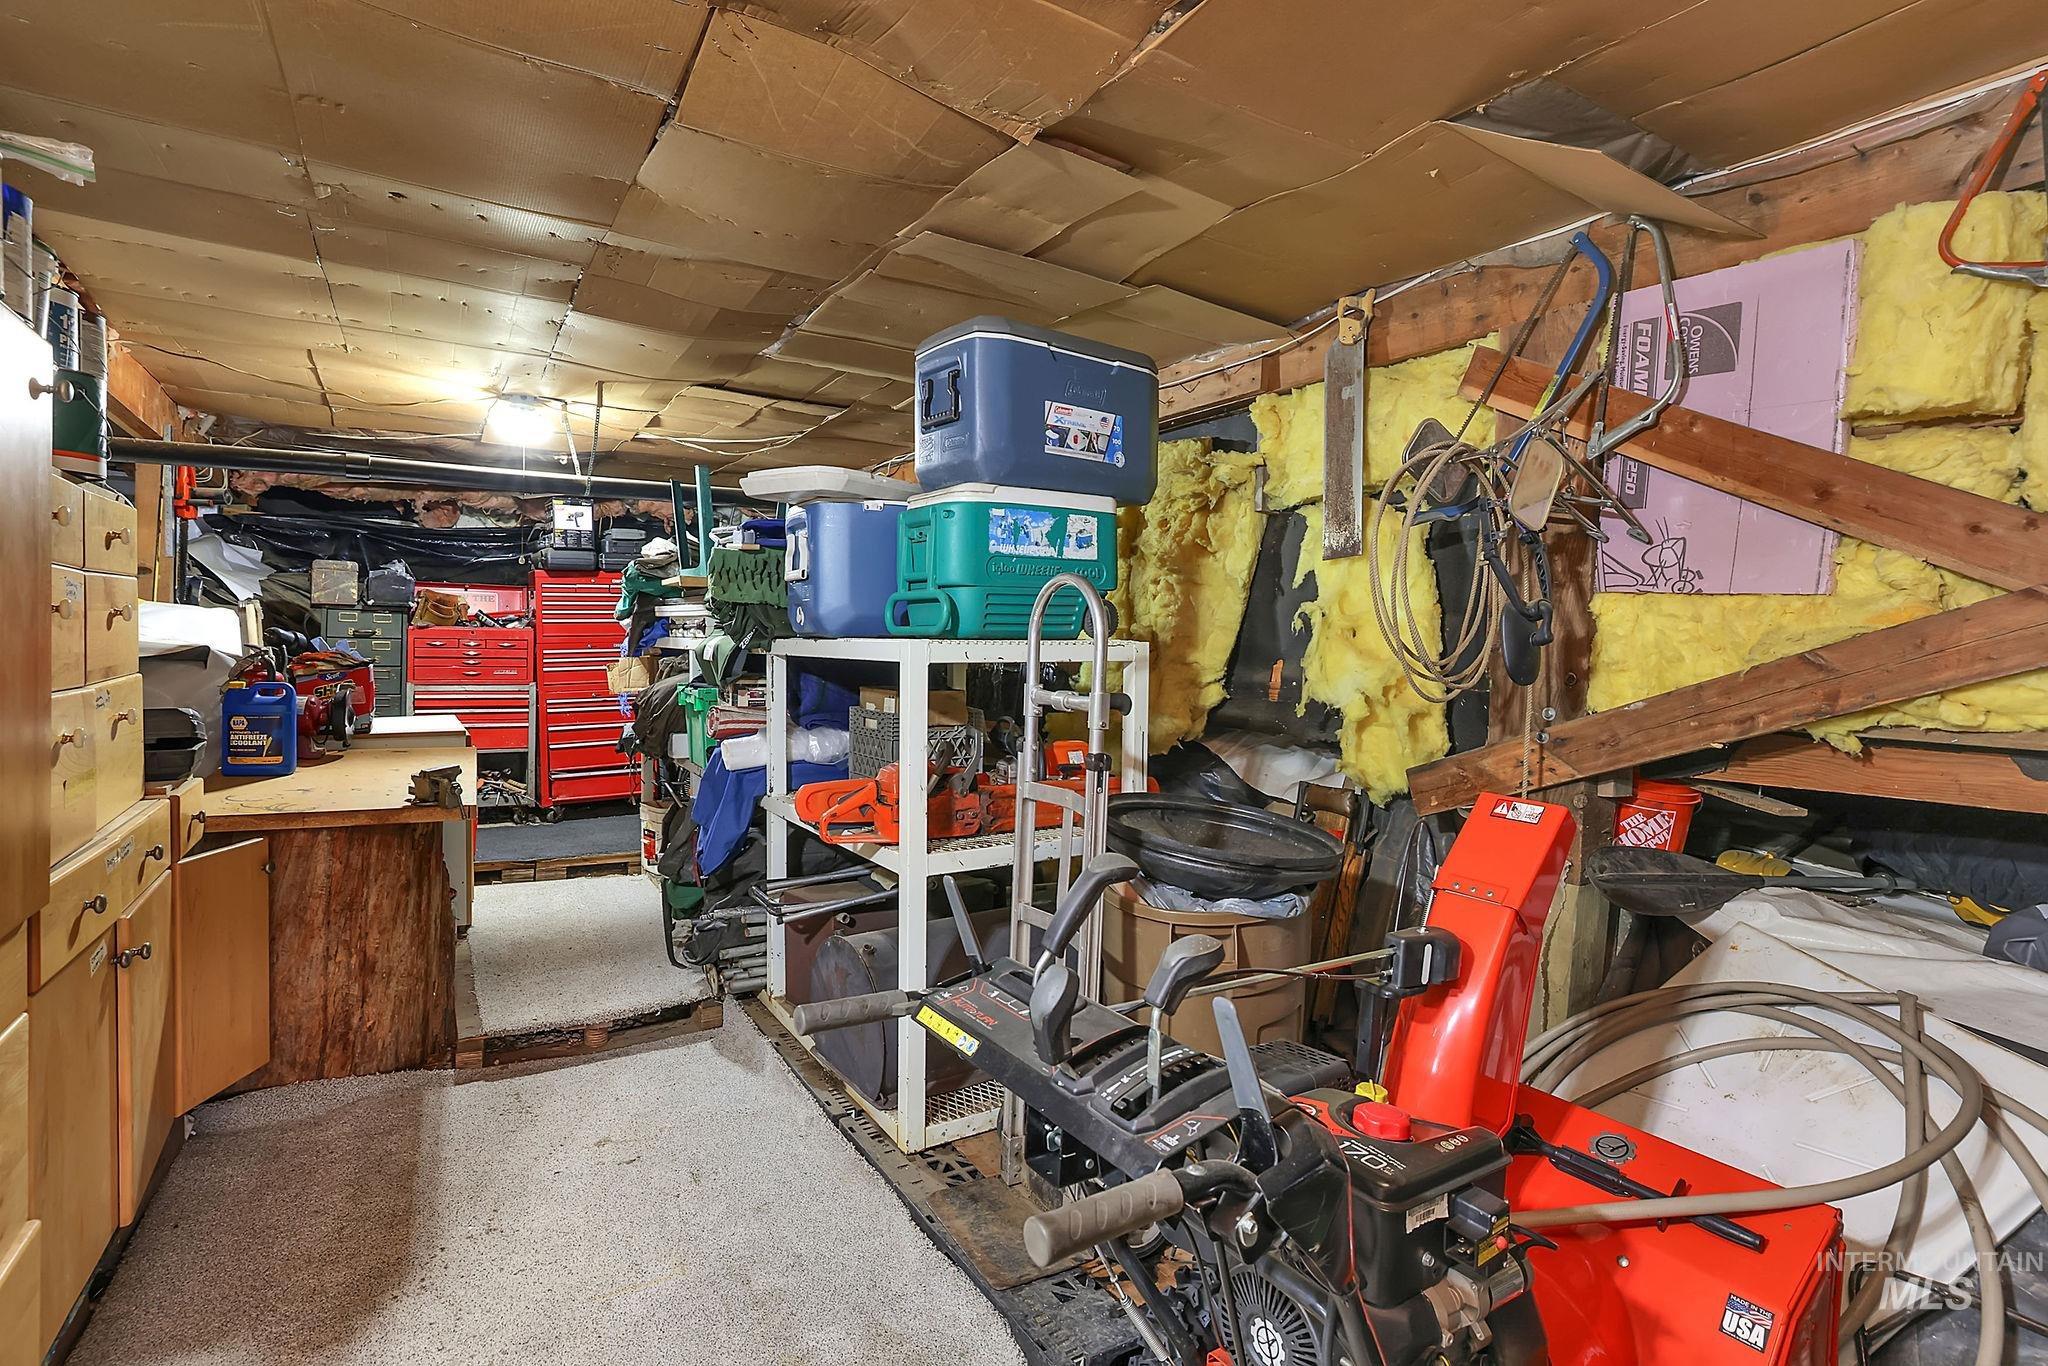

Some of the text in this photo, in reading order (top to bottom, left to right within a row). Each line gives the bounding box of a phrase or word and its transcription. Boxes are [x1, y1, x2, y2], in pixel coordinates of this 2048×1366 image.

[1688, 325, 1703, 375] OWENS
[1625, 460, 1638, 495] 250
[1619, 812, 1648, 831] THE
[1730, 1294, 1751, 1309] MADE
[1759, 1307, 1773, 1318] THE
[1722, 1309, 1766, 1349] USA
